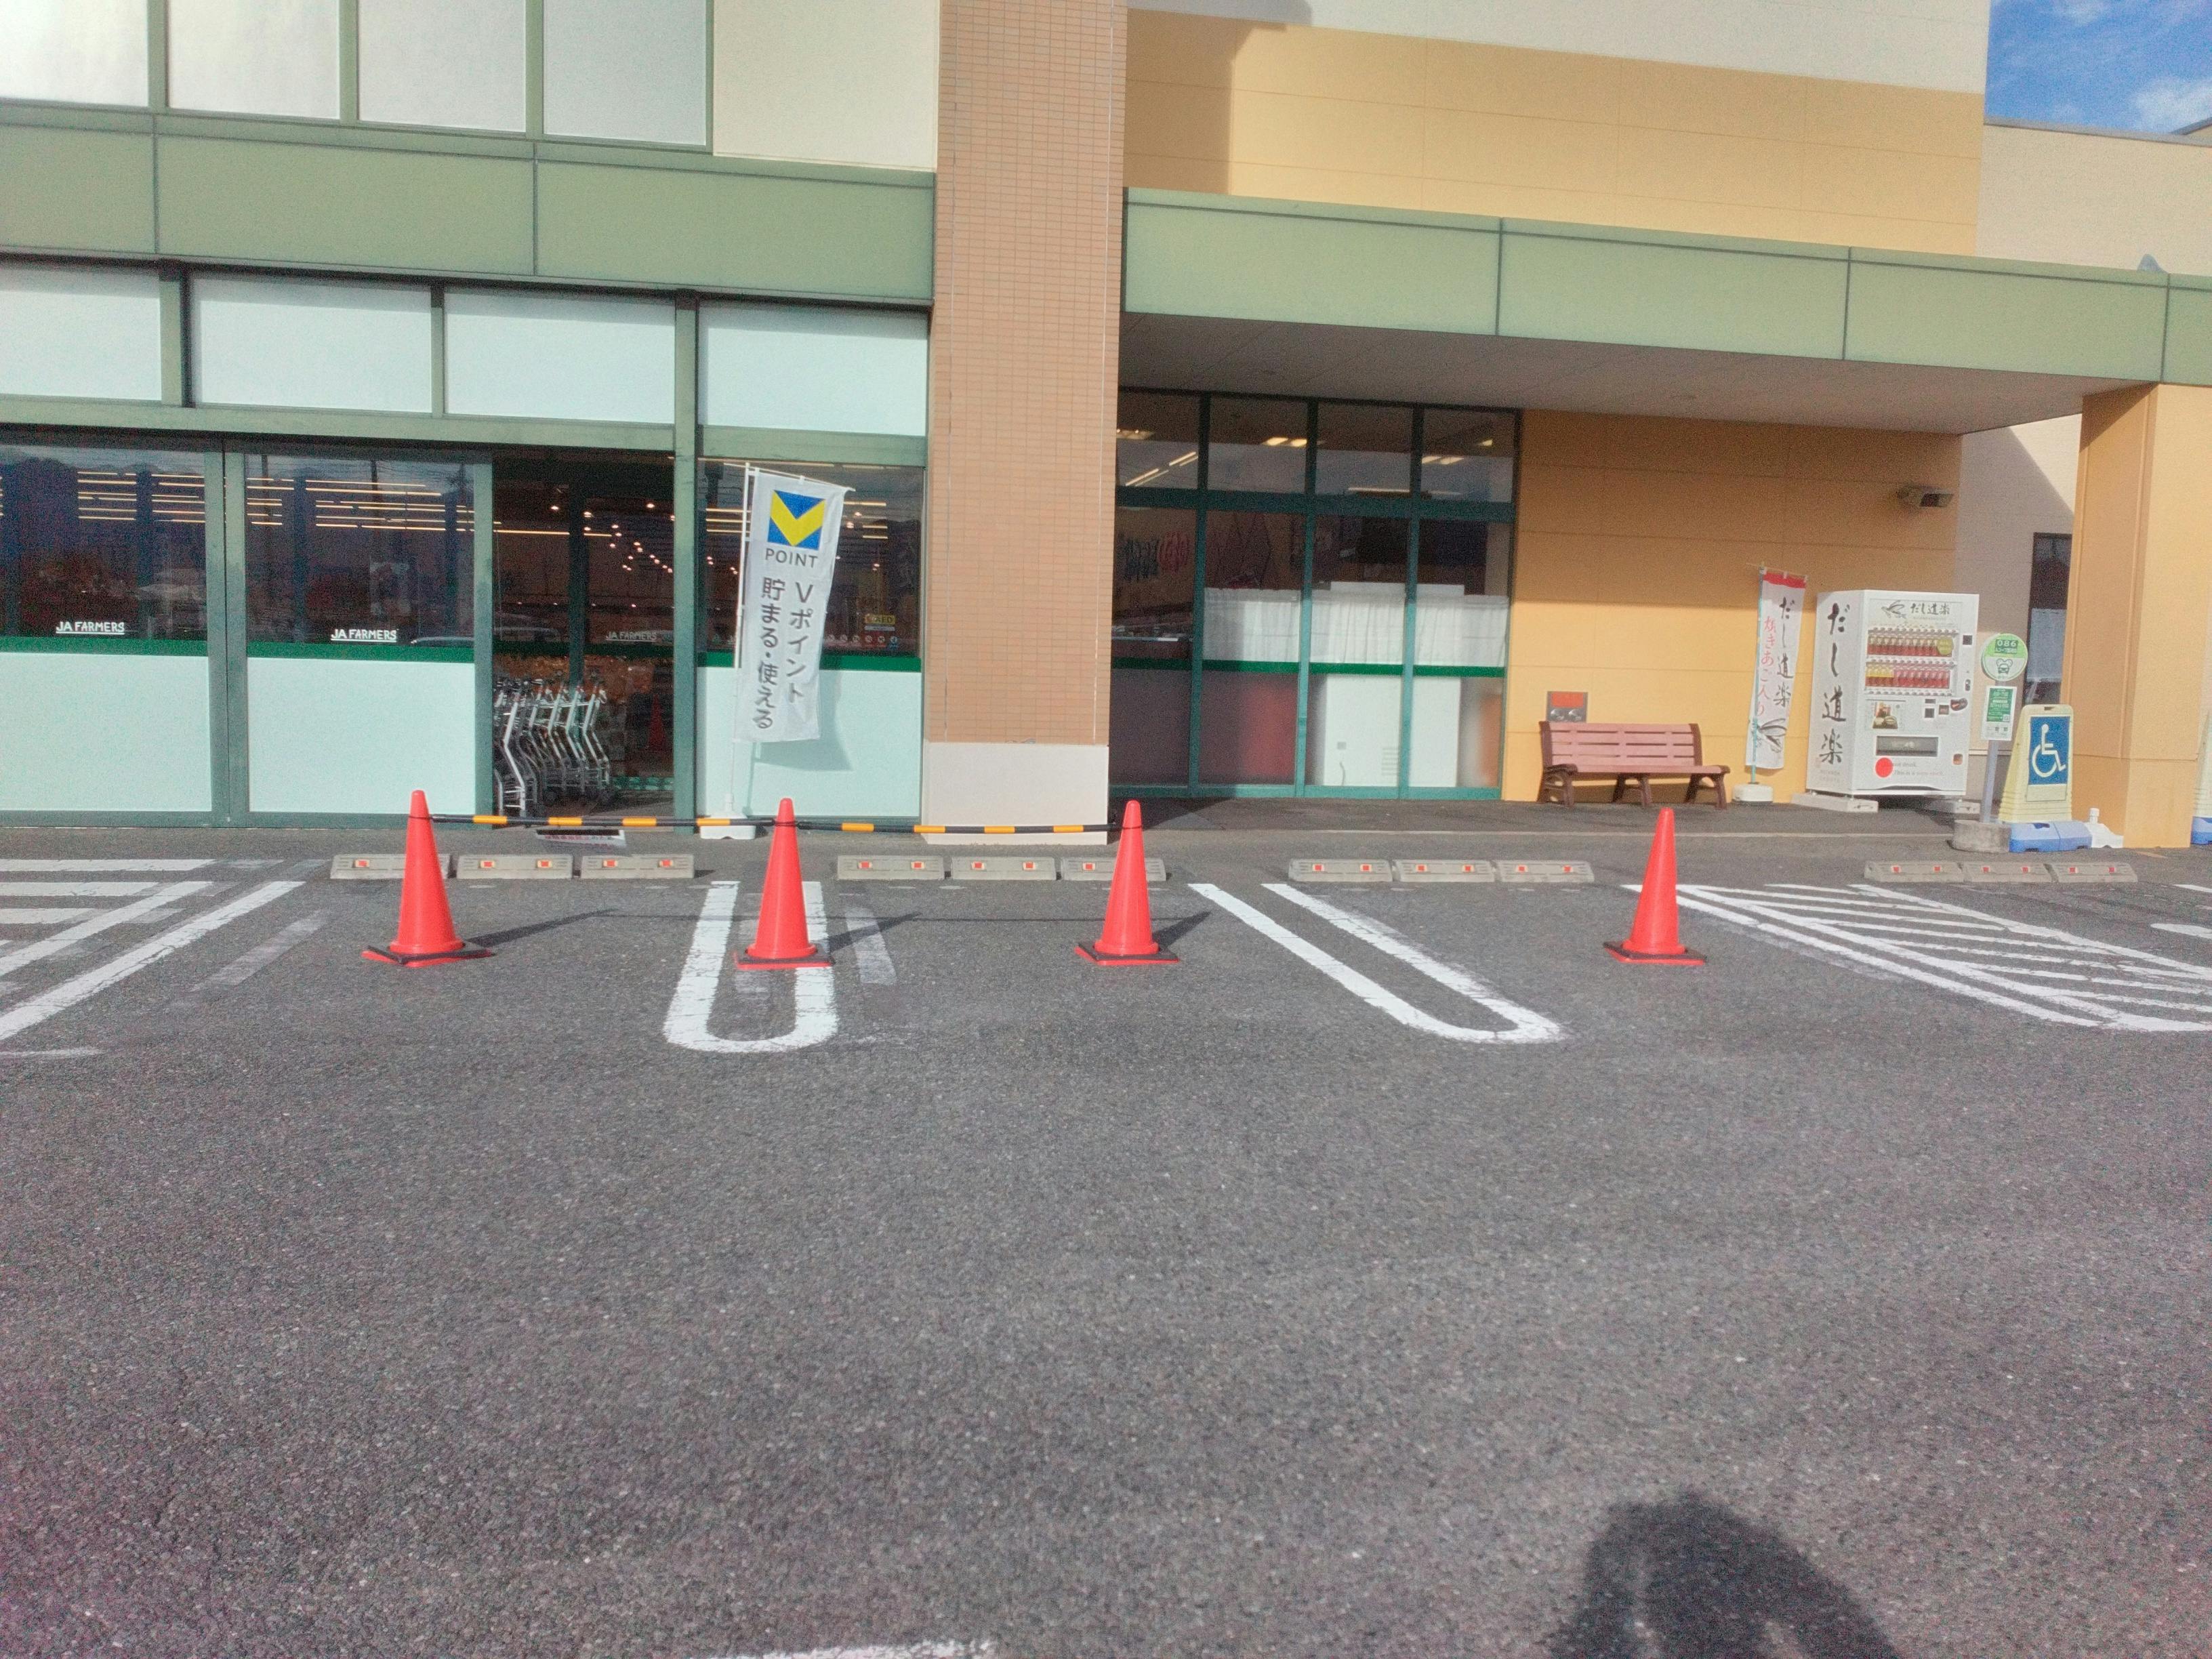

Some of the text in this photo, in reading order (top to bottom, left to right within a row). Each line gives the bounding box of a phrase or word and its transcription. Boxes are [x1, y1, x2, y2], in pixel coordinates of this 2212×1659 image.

[765, 548, 818, 568] POINT
[56, 621, 125, 633] JA FARMERS
[331, 628, 397, 640] JA FARMERS
[619, 631, 657, 641] FARMERS
[1910, 602, 1950, 615] だし道楽
[752, 577, 786, 730] 貯まる・使える
[786, 581, 814, 703] Vポイント
[1757, 615, 1776, 716] 焼きあご入り
[1773, 596, 1795, 708] だし道楽
[1819, 602, 1850, 765] だし道楽
